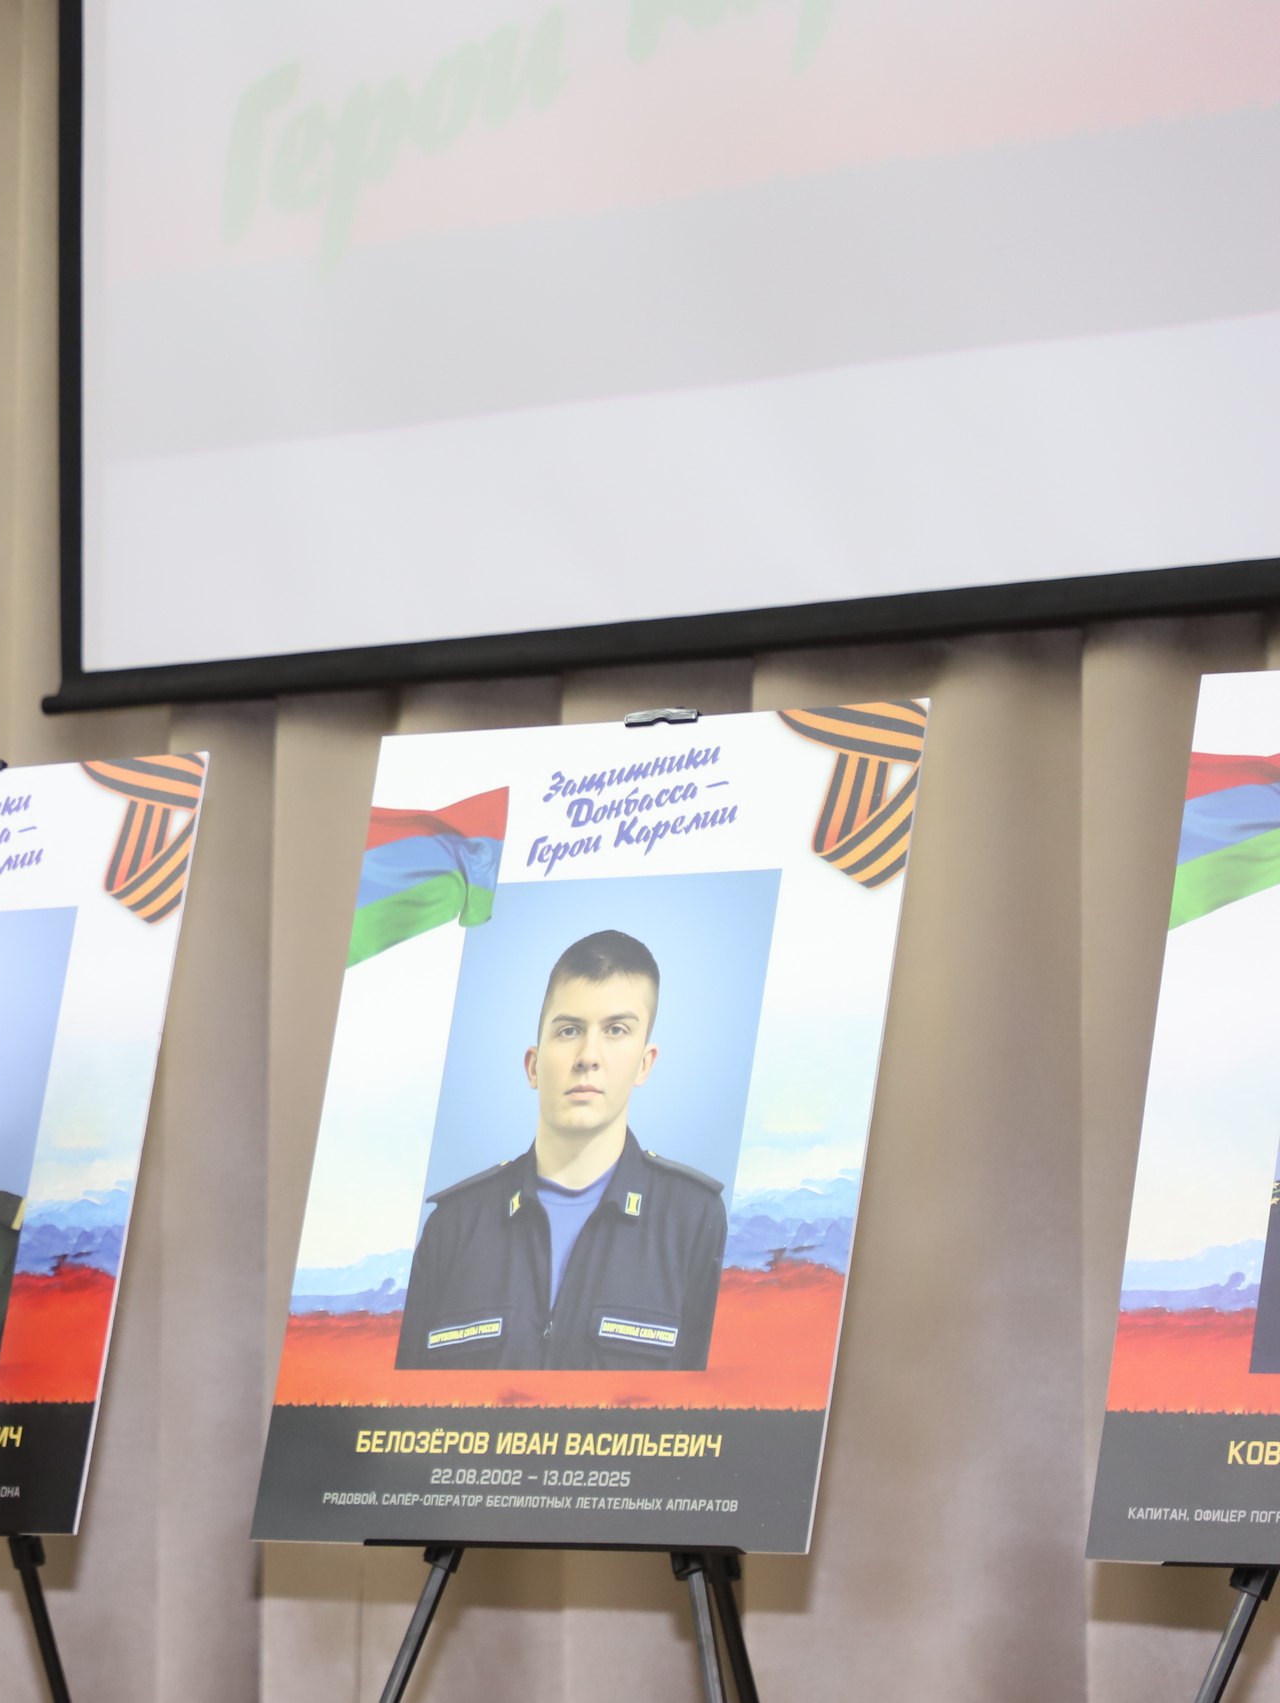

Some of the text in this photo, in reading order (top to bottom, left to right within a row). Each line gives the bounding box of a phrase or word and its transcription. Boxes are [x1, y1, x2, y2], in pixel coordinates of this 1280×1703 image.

[220, 7, 566, 286] Герои
[542, 746, 721, 803] Защитники
[566, 782, 699, 829] Донбасса
[527, 805, 738, 877] Герои Карелии
[355, 1428, 723, 1457] БЕЛОЗЁРОВ ИВАН ВАСИЛЬЕВИЧ
[430, 1468, 523, 1486] 22.08.2002
[543, 1470, 631, 1487] 13.02.2025
[382, 1492, 483, 1507] САПЁР-ОПЕРАТОР
[485, 1495, 573, 1509] БЕСПИЛОТНЫХ
[575, 1496, 662, 1511] ЛЕТАТЕЛЬНЫХ
[666, 1498, 739, 1513] АППАРАТОВ
[1128, 1507, 1190, 1522] КАПИТАН,
[1194, 1509, 1247, 1524] ОФИЦЕР
